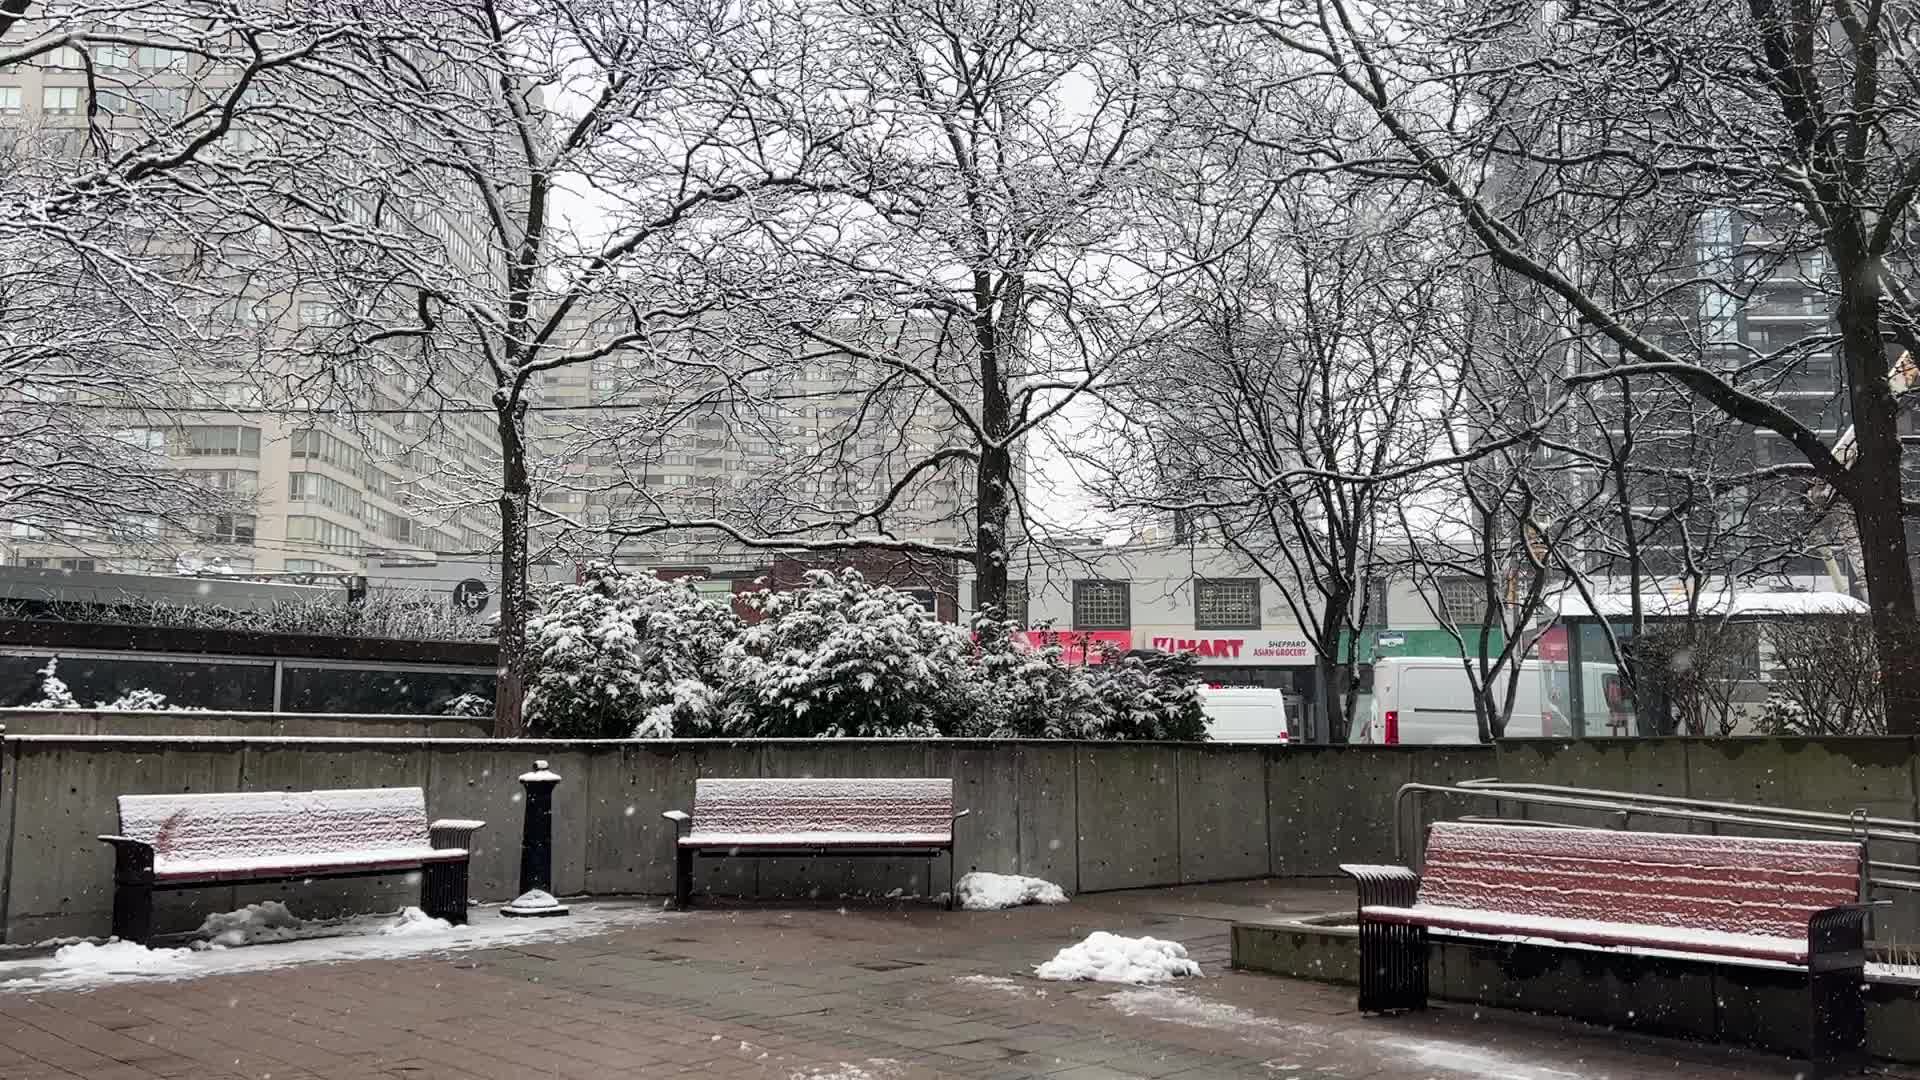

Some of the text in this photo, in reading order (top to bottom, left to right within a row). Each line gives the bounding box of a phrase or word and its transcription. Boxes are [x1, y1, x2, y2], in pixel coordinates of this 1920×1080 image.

[1268, 640, 1307, 648] SHEPPARD
[1253, 648, 1307, 656] ASIAN GROCERY
